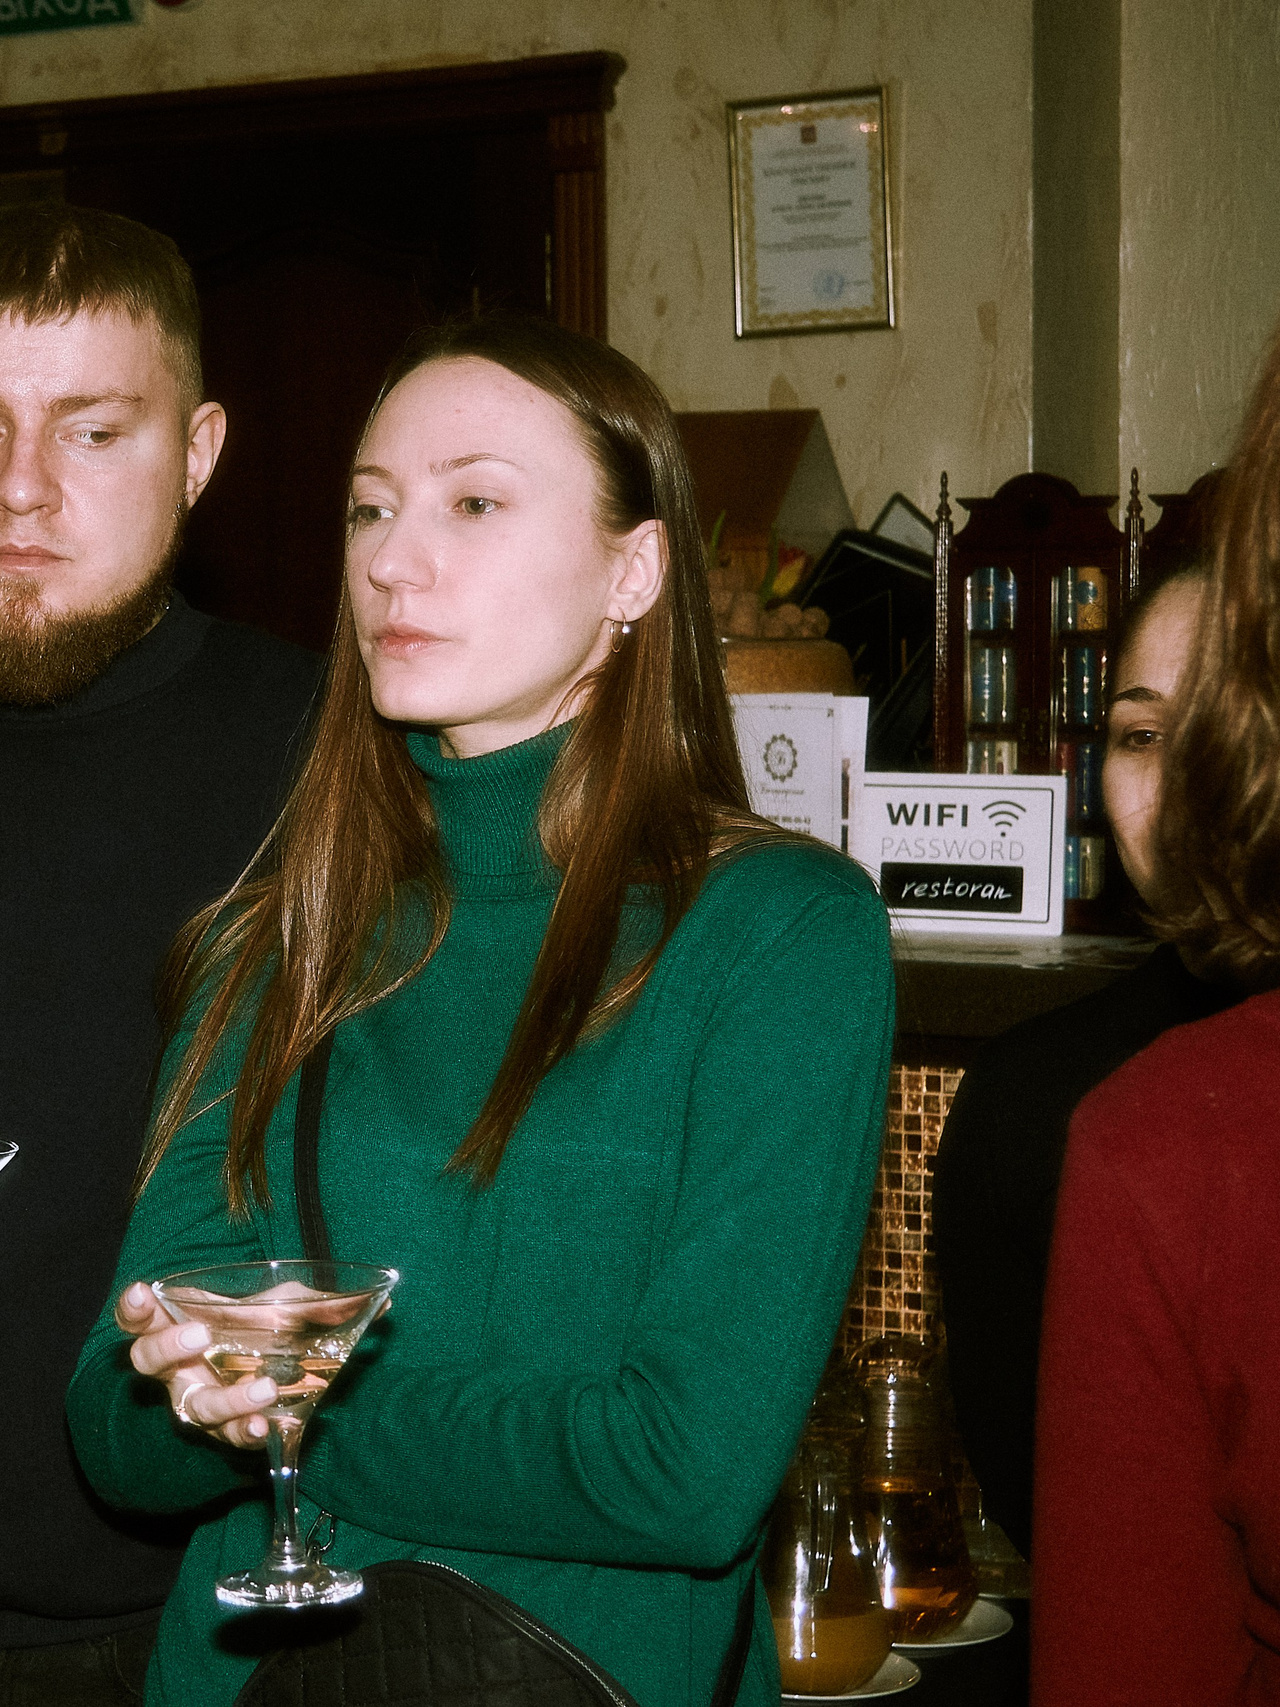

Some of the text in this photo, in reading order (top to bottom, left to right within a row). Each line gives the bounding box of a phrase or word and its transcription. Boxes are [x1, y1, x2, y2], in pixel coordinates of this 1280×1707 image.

[886, 803, 969, 827] WIFI
[880, 837, 1024, 861] PASSWORD
[901, 877, 1012, 900] restoran
